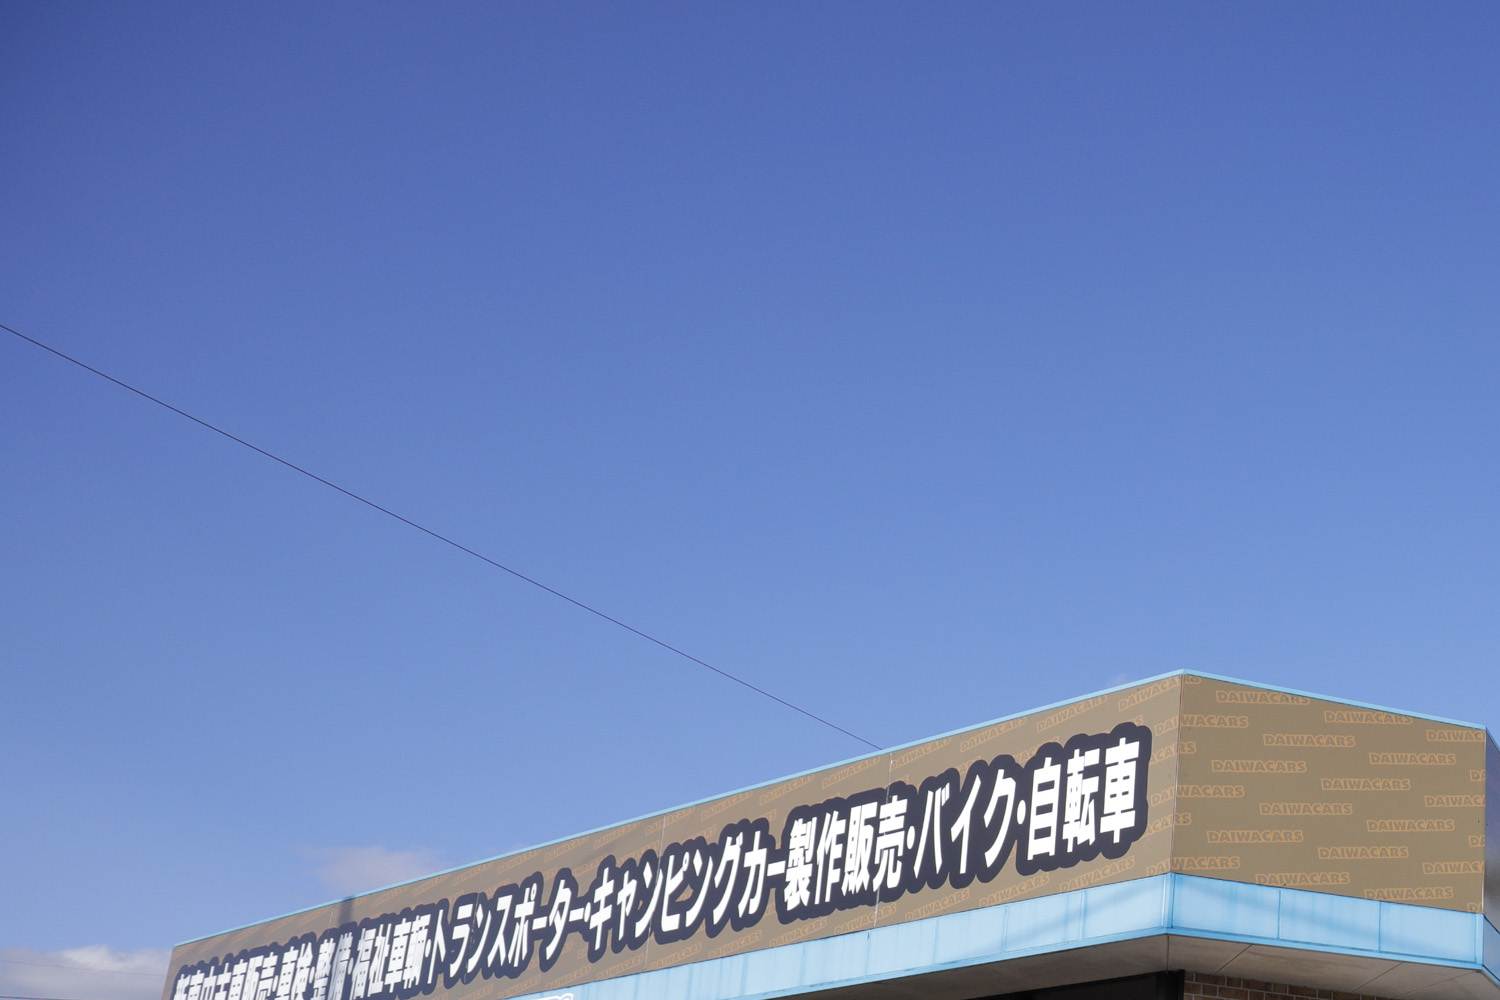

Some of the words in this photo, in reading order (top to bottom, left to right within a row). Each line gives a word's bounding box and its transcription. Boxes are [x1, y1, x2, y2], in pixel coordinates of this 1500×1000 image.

[1216, 690, 1310, 705] DAIWACARS
[1324, 711, 1413, 724] DAIWACARS
[1263, 734, 1356, 747] DAIWACARS
[1369, 752, 1456, 765] DAIWACARS
[1211, 759, 1306, 773] DAIWACARS
[1321, 778, 1410, 791] DAIWACARS
[1259, 802, 1352, 815] DAIWACARS
[1367, 819, 1454, 832] DAIWACARS
[1207, 830, 1303, 843] DAIWACARS
[1318, 846, 1409, 859] DAIWACARS
[1060, 856, 1135, 892] DAIWACARS
[1255, 872, 1349, 886] DAIWACARS
[1364, 887, 1453, 900] DAIWACARS
